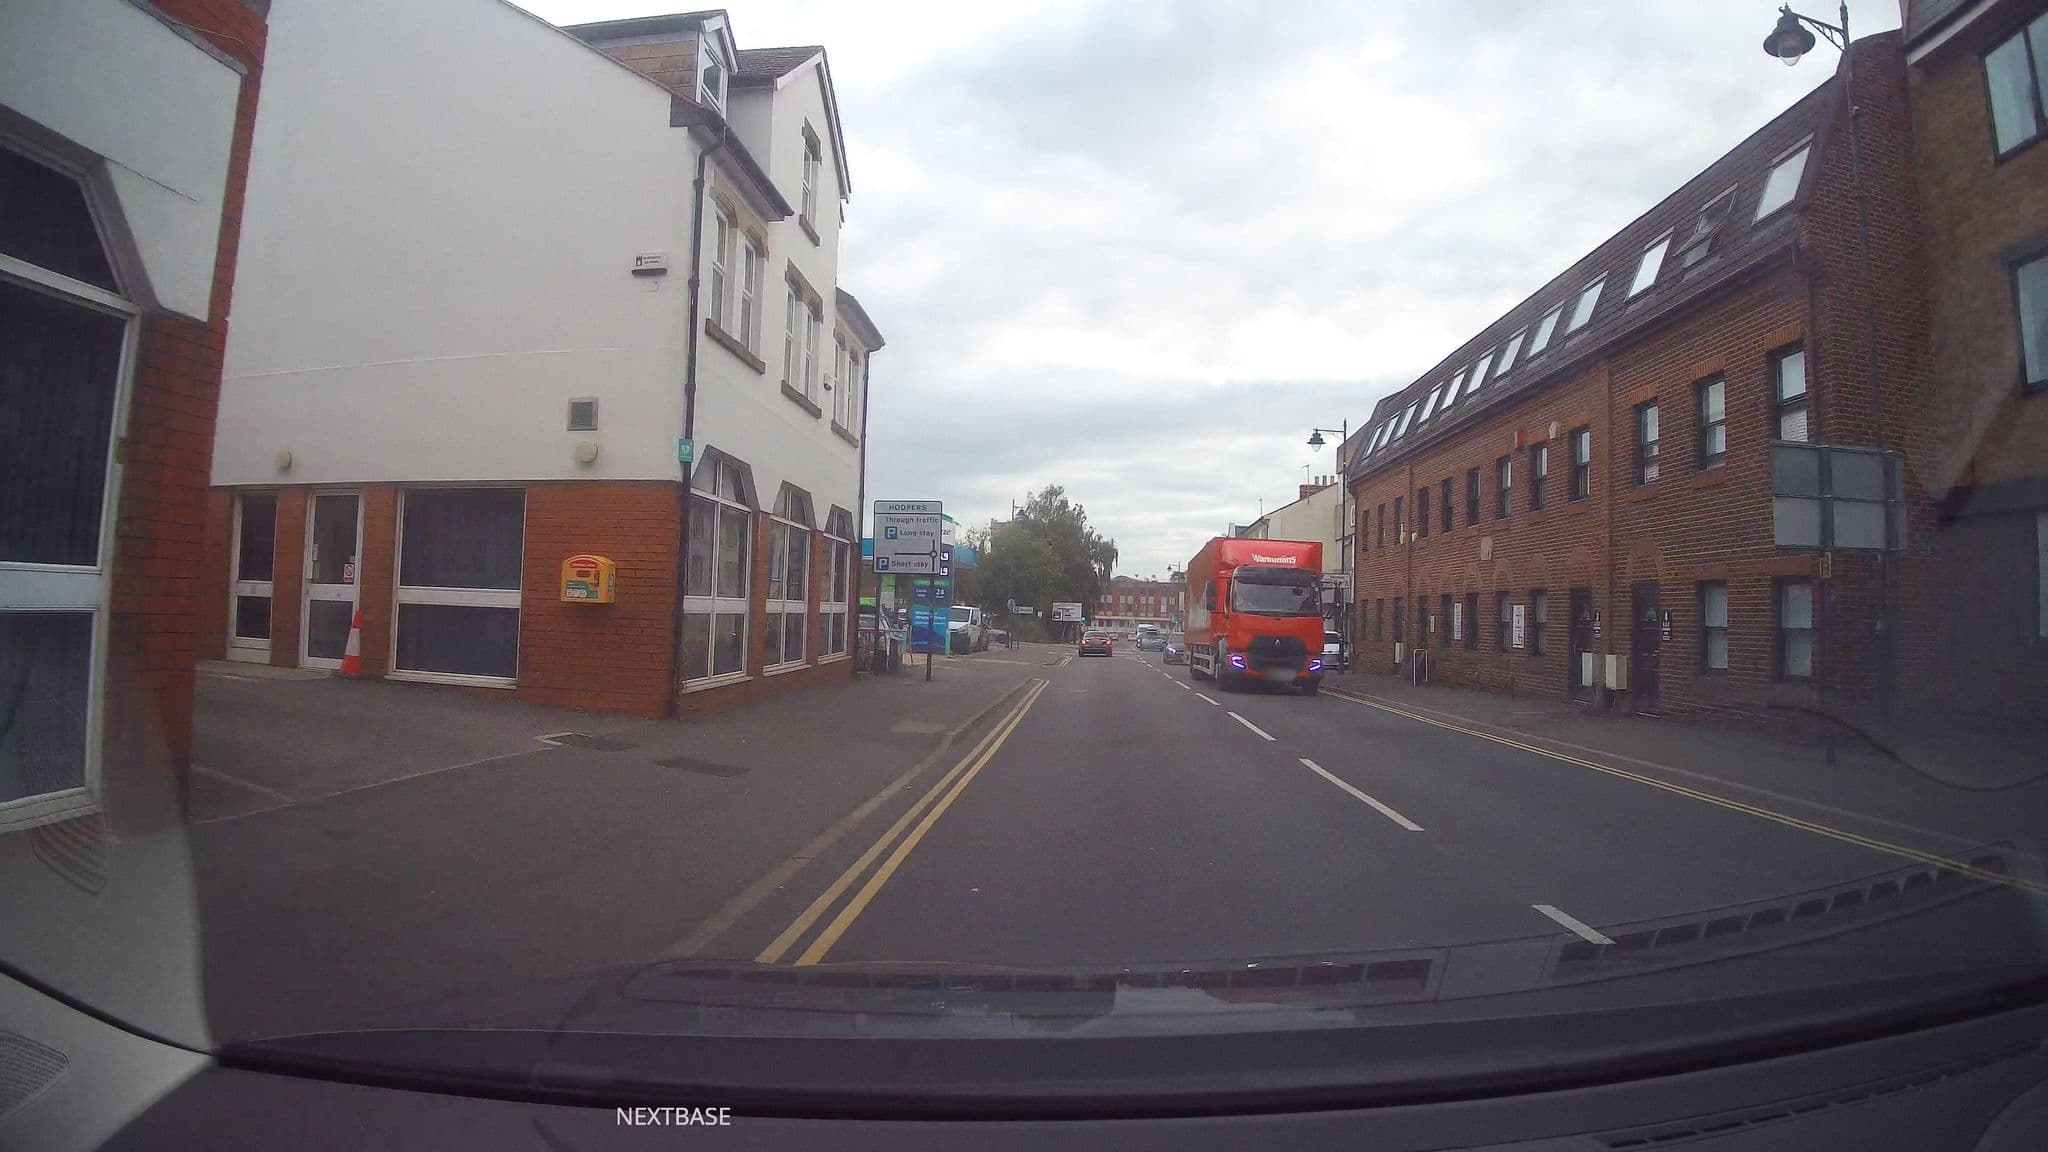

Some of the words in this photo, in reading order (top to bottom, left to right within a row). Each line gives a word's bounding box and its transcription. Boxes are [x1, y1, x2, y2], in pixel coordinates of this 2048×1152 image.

[885, 516, 914, 524] Through
[916, 516, 939, 524] traffic
[891, 560, 912, 568] Short
[913, 560, 929, 569] stay
